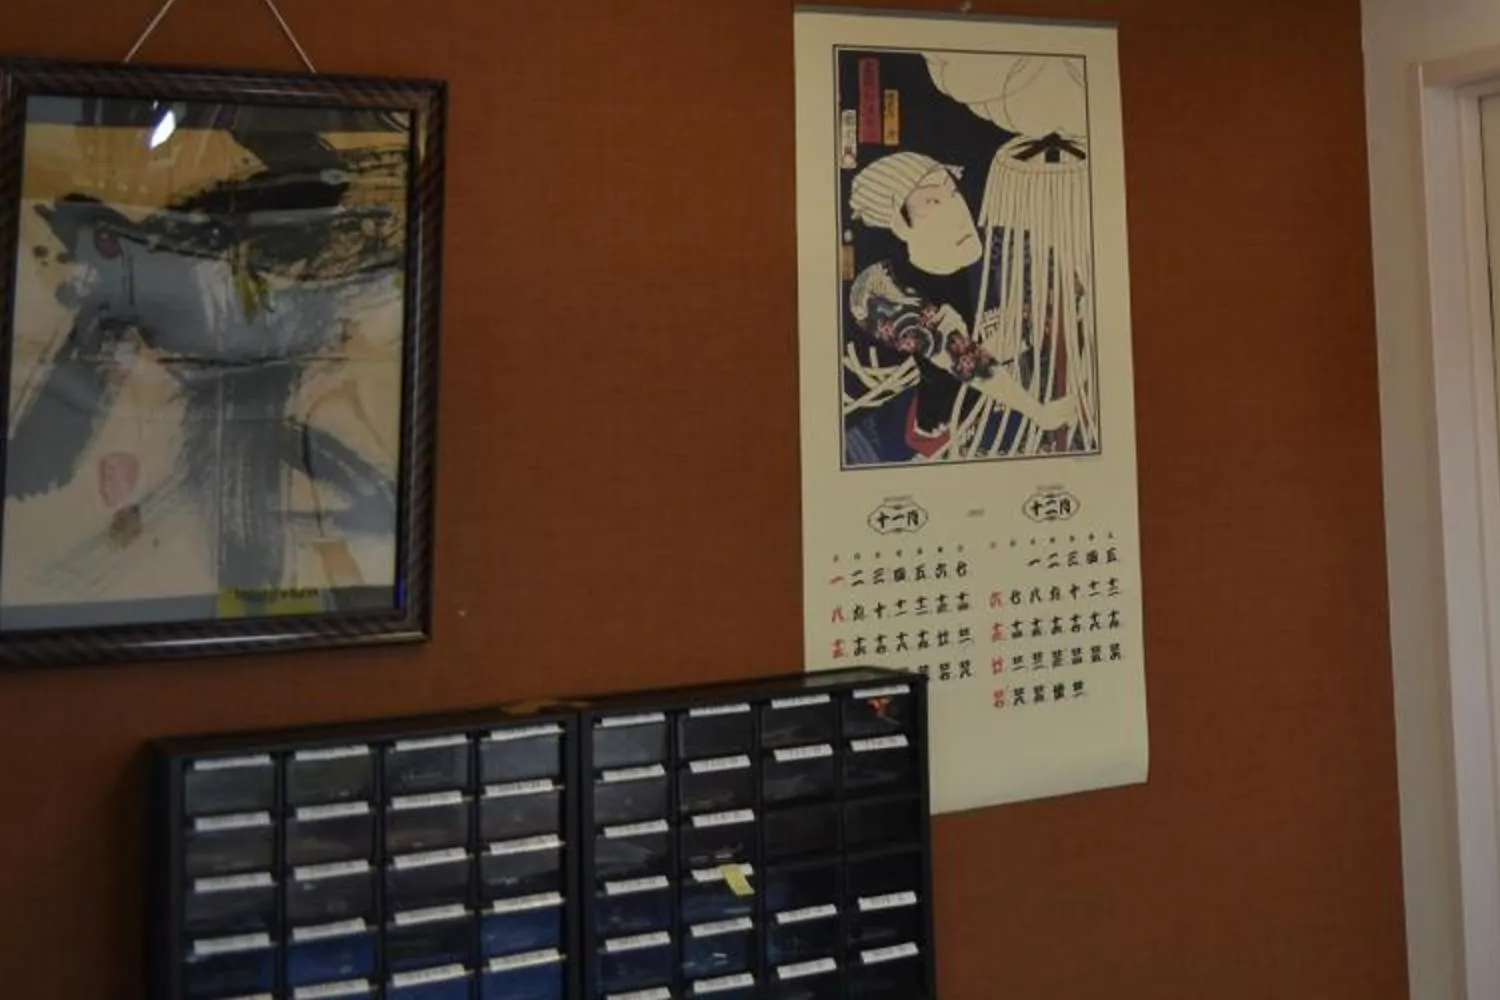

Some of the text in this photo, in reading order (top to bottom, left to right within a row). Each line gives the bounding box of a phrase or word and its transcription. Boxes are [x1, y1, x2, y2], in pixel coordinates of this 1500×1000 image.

[1030, 498, 1071, 516] 十二月
[876, 511, 919, 529] 十一月
